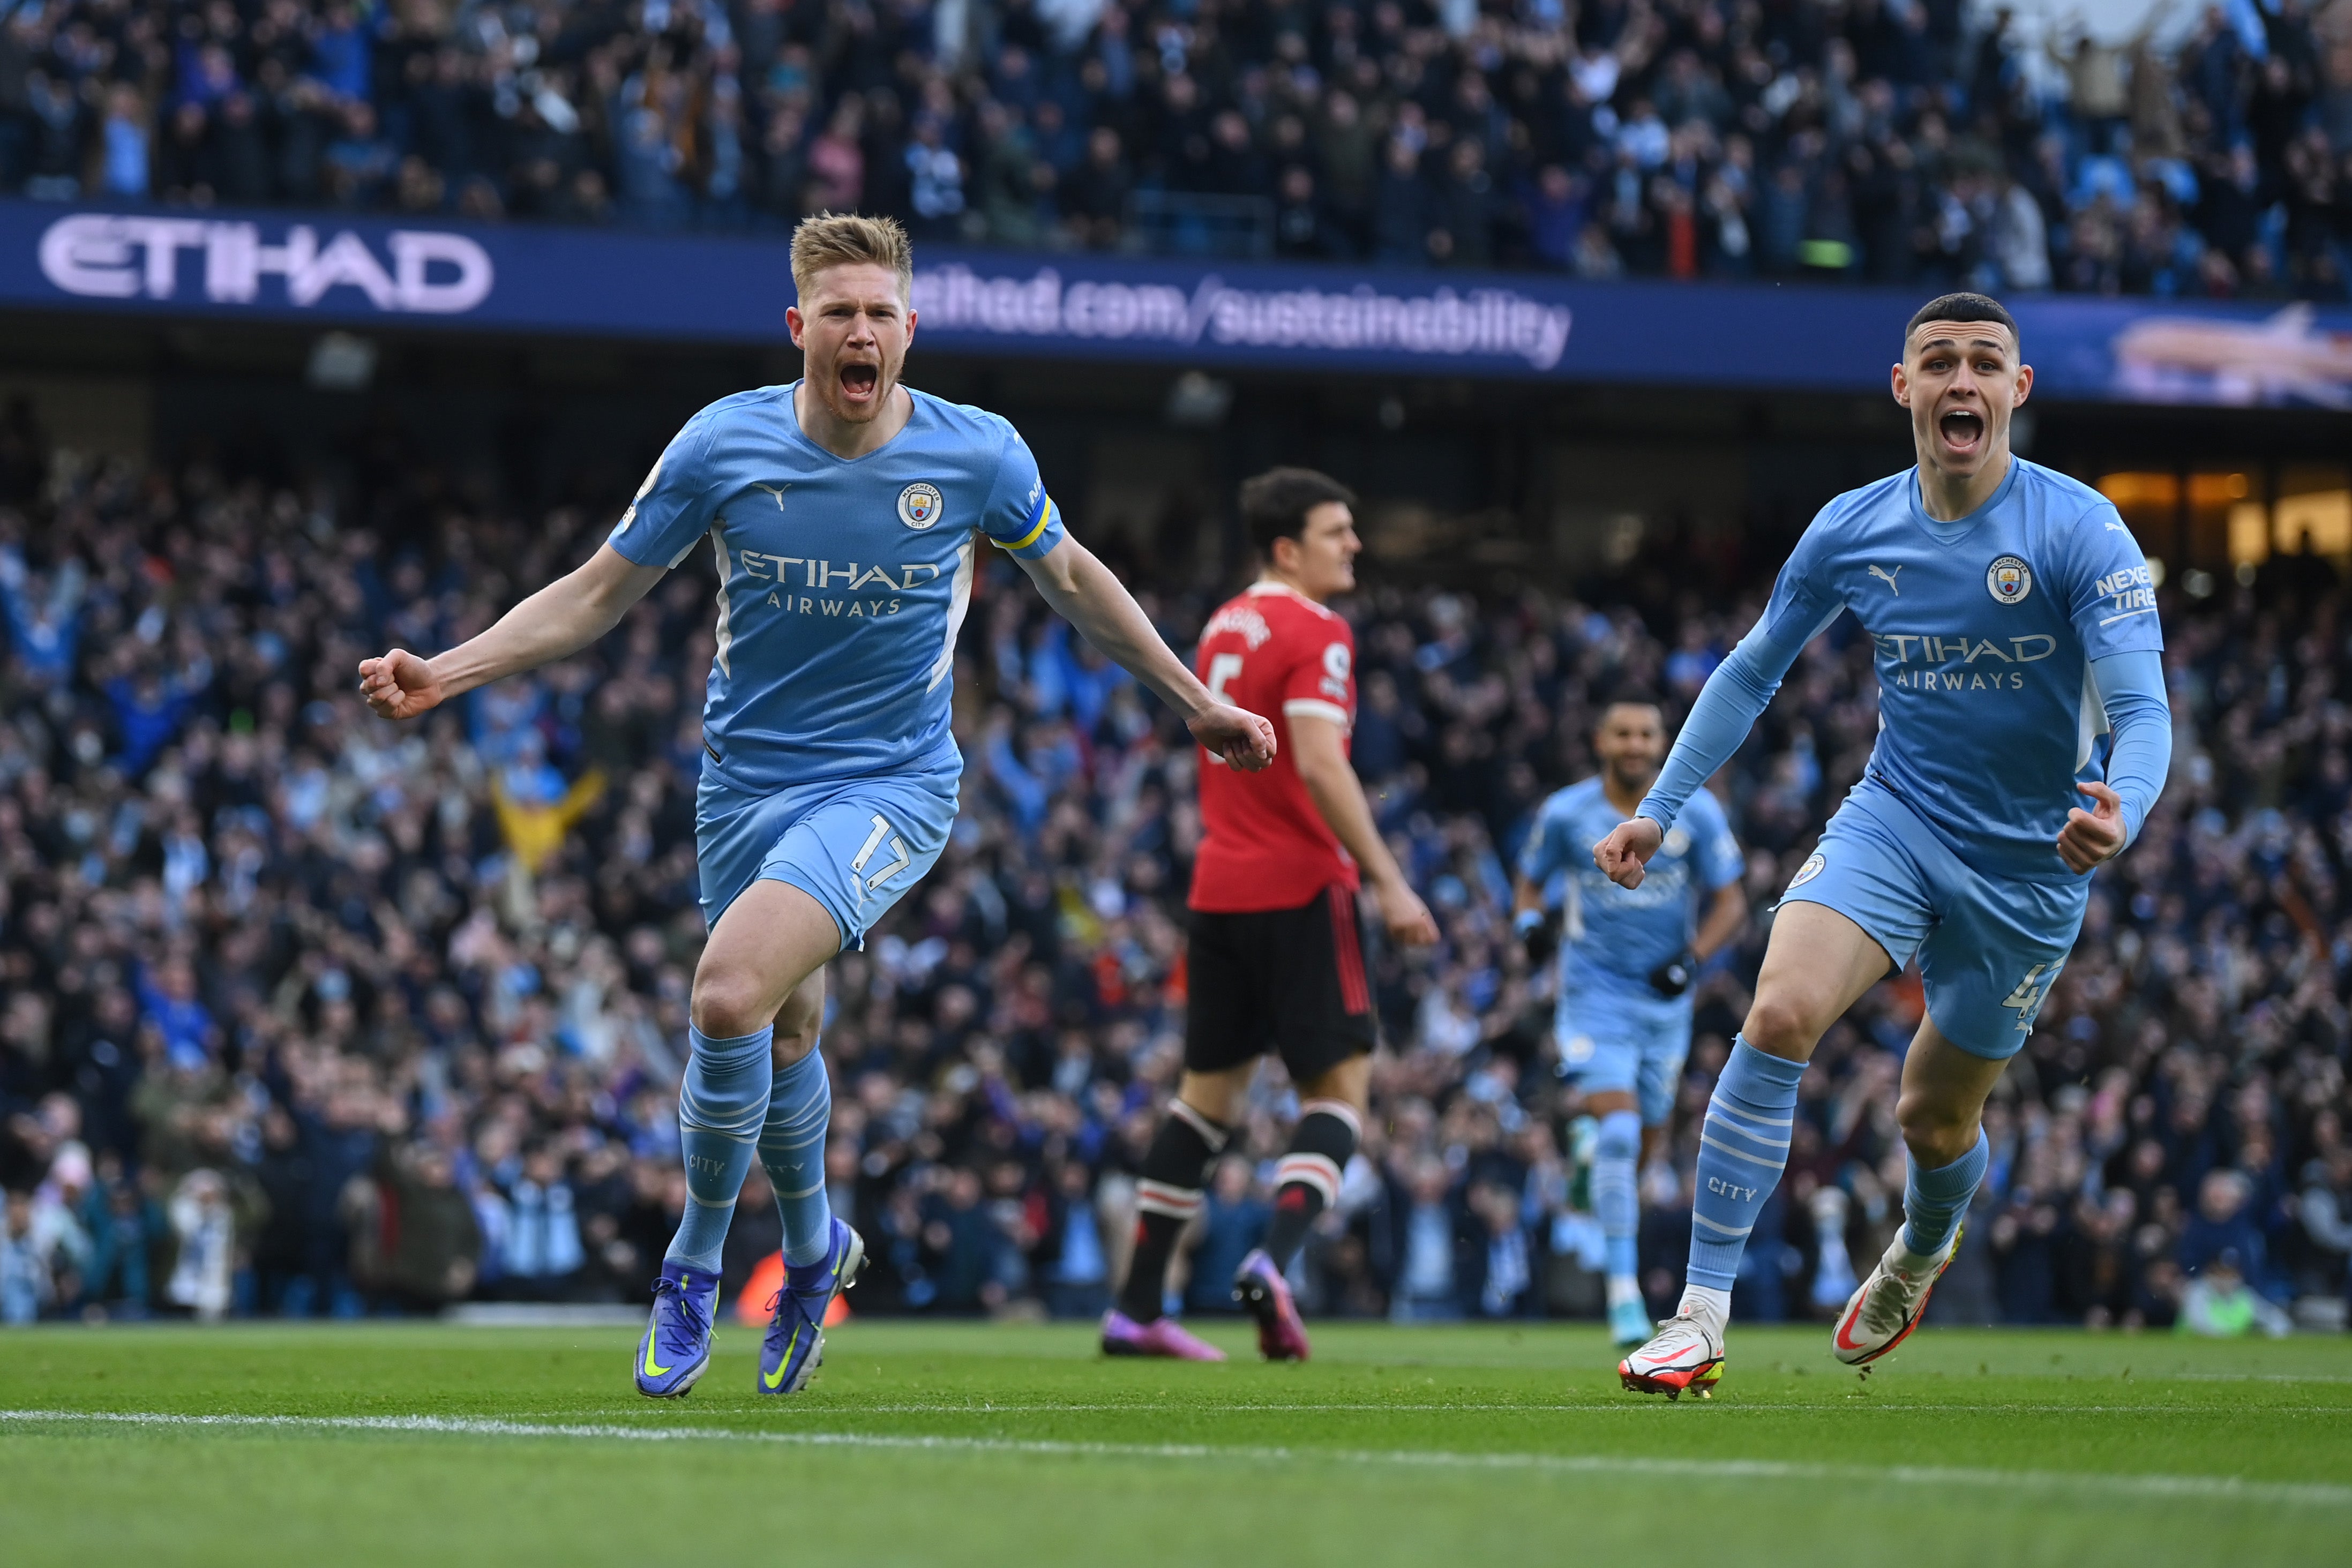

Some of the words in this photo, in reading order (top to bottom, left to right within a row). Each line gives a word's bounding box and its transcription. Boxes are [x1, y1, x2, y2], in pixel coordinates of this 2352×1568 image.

[39, 214, 494, 313] ETIHAD
[910, 262, 1571, 371] tihad.com/sustainability
[902, 484, 940, 501] MANCHESTER
[740, 549, 940, 590] ETIHAD
[1990, 558, 2028, 574] MANCHESTER
[2095, 566, 2150, 597] NEXE
[767, 591, 901, 617] AIRWAYS
[1871, 634, 2057, 663] ETIHAD
[1896, 669, 2024, 691] AIRWAYS
[850, 813, 910, 892] 17
[690, 1154, 725, 1176] CITY
[1707, 1176, 1757, 1203] CITY
